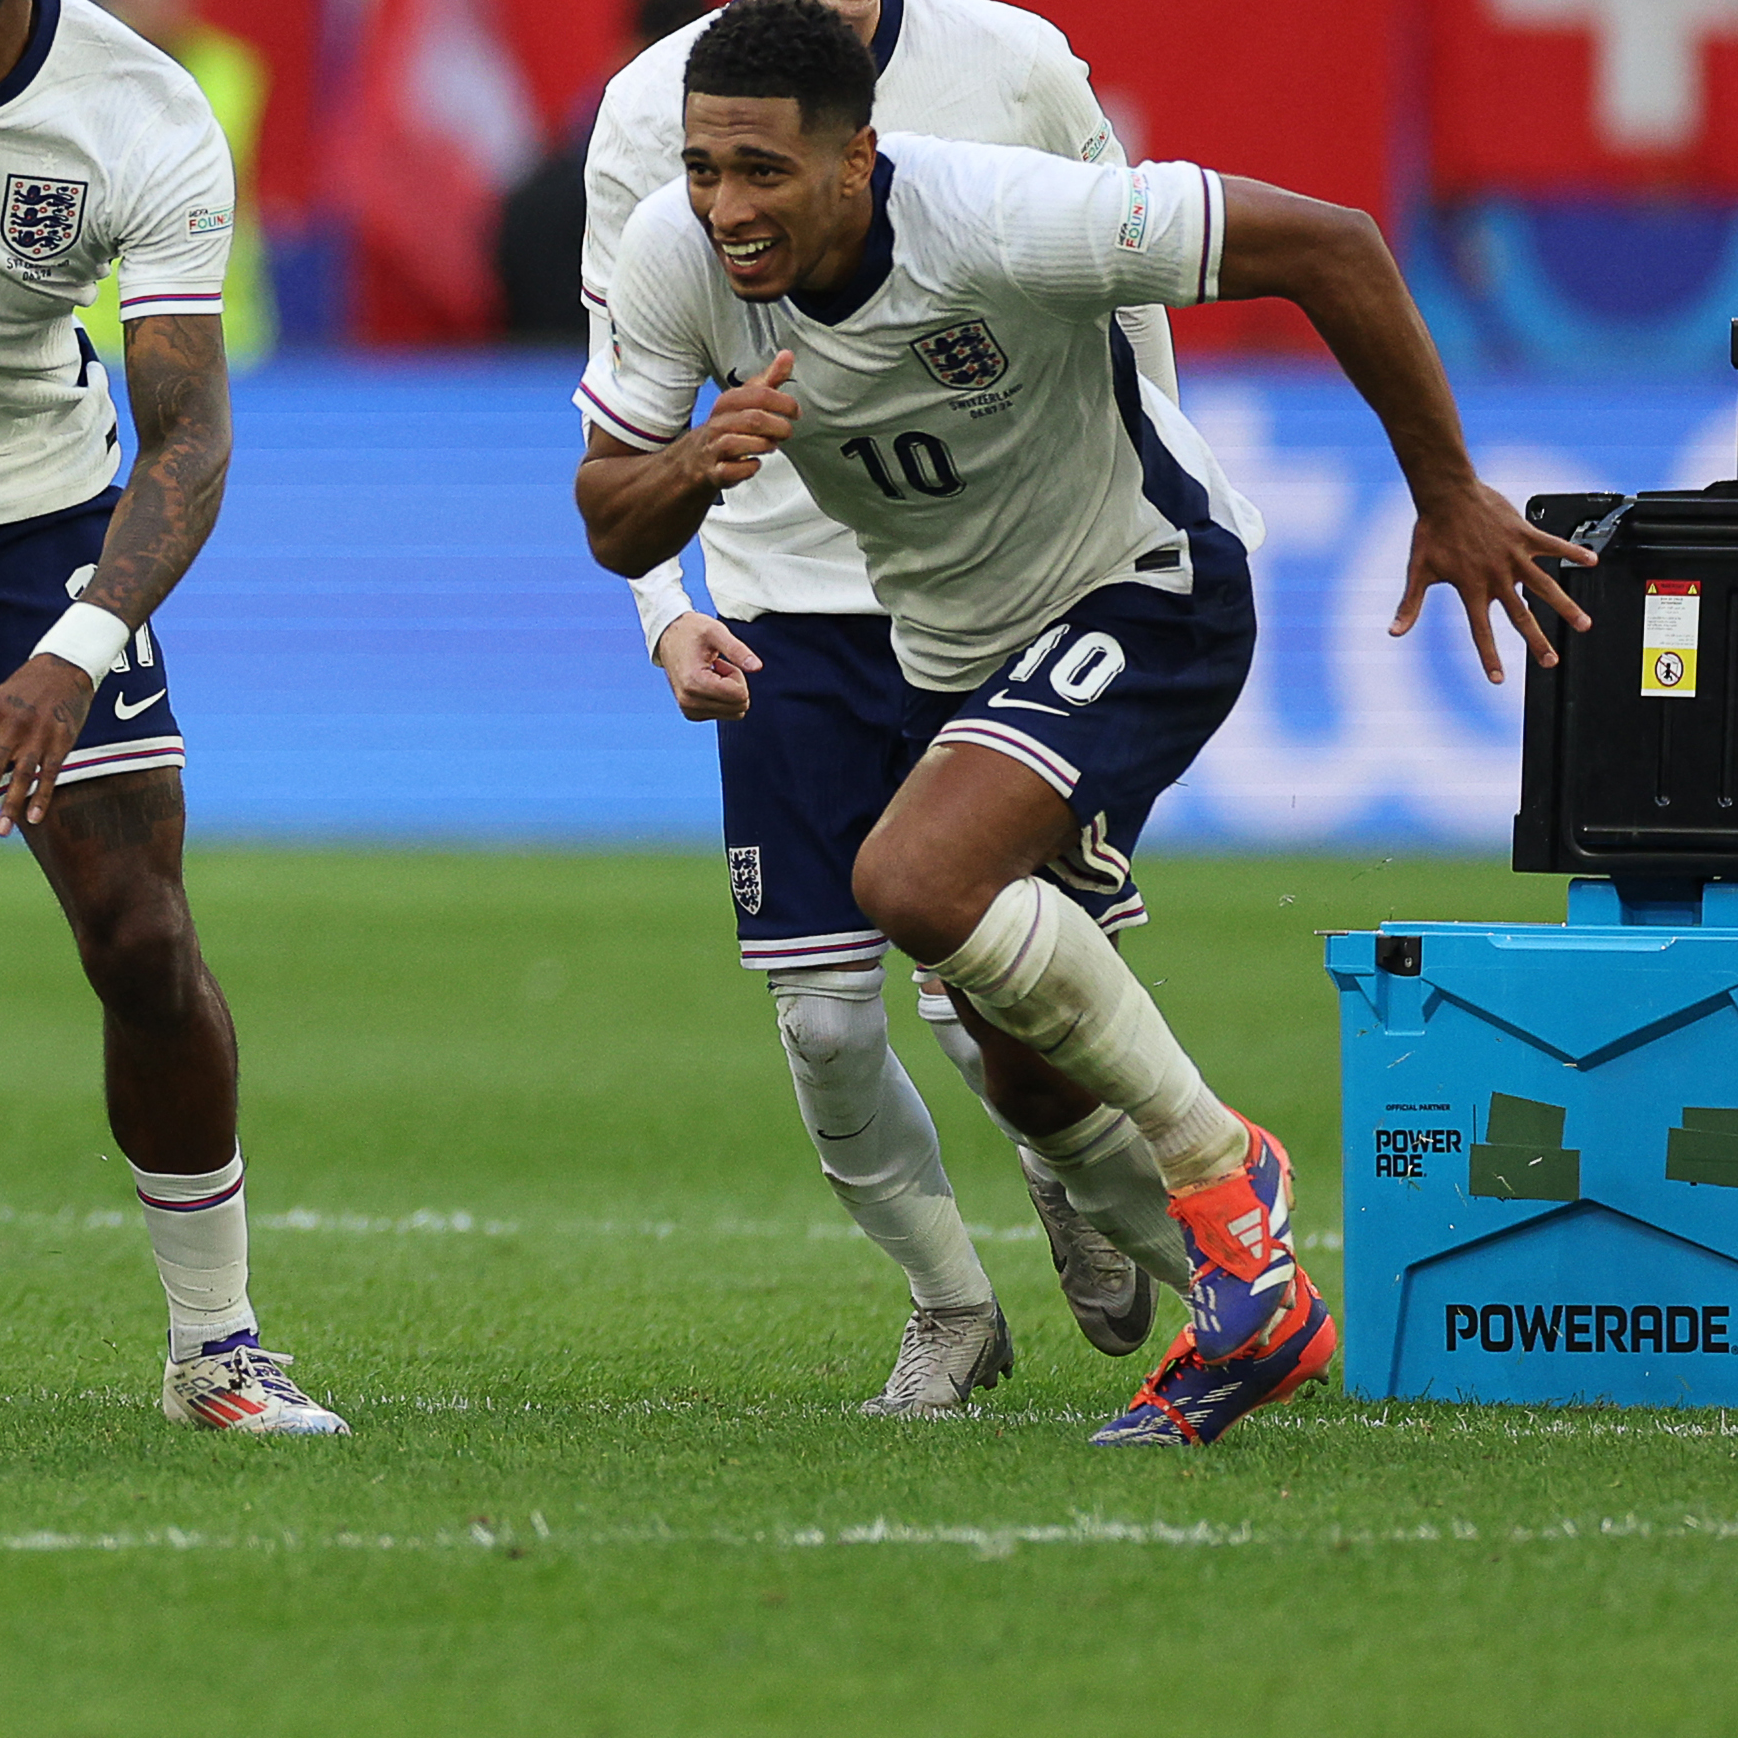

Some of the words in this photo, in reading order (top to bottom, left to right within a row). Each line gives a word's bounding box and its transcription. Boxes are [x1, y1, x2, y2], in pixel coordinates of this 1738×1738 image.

[840, 431, 967, 501] 10
[1009, 623, 1126, 706] 10
[1385, 1104, 1418, 1112] OFFICIAL
[1419, 1104, 1451, 1112] PARTNER
[1376, 1129, 1462, 1153] POWER
[1445, 1304, 1730, 1354] POWERADE
